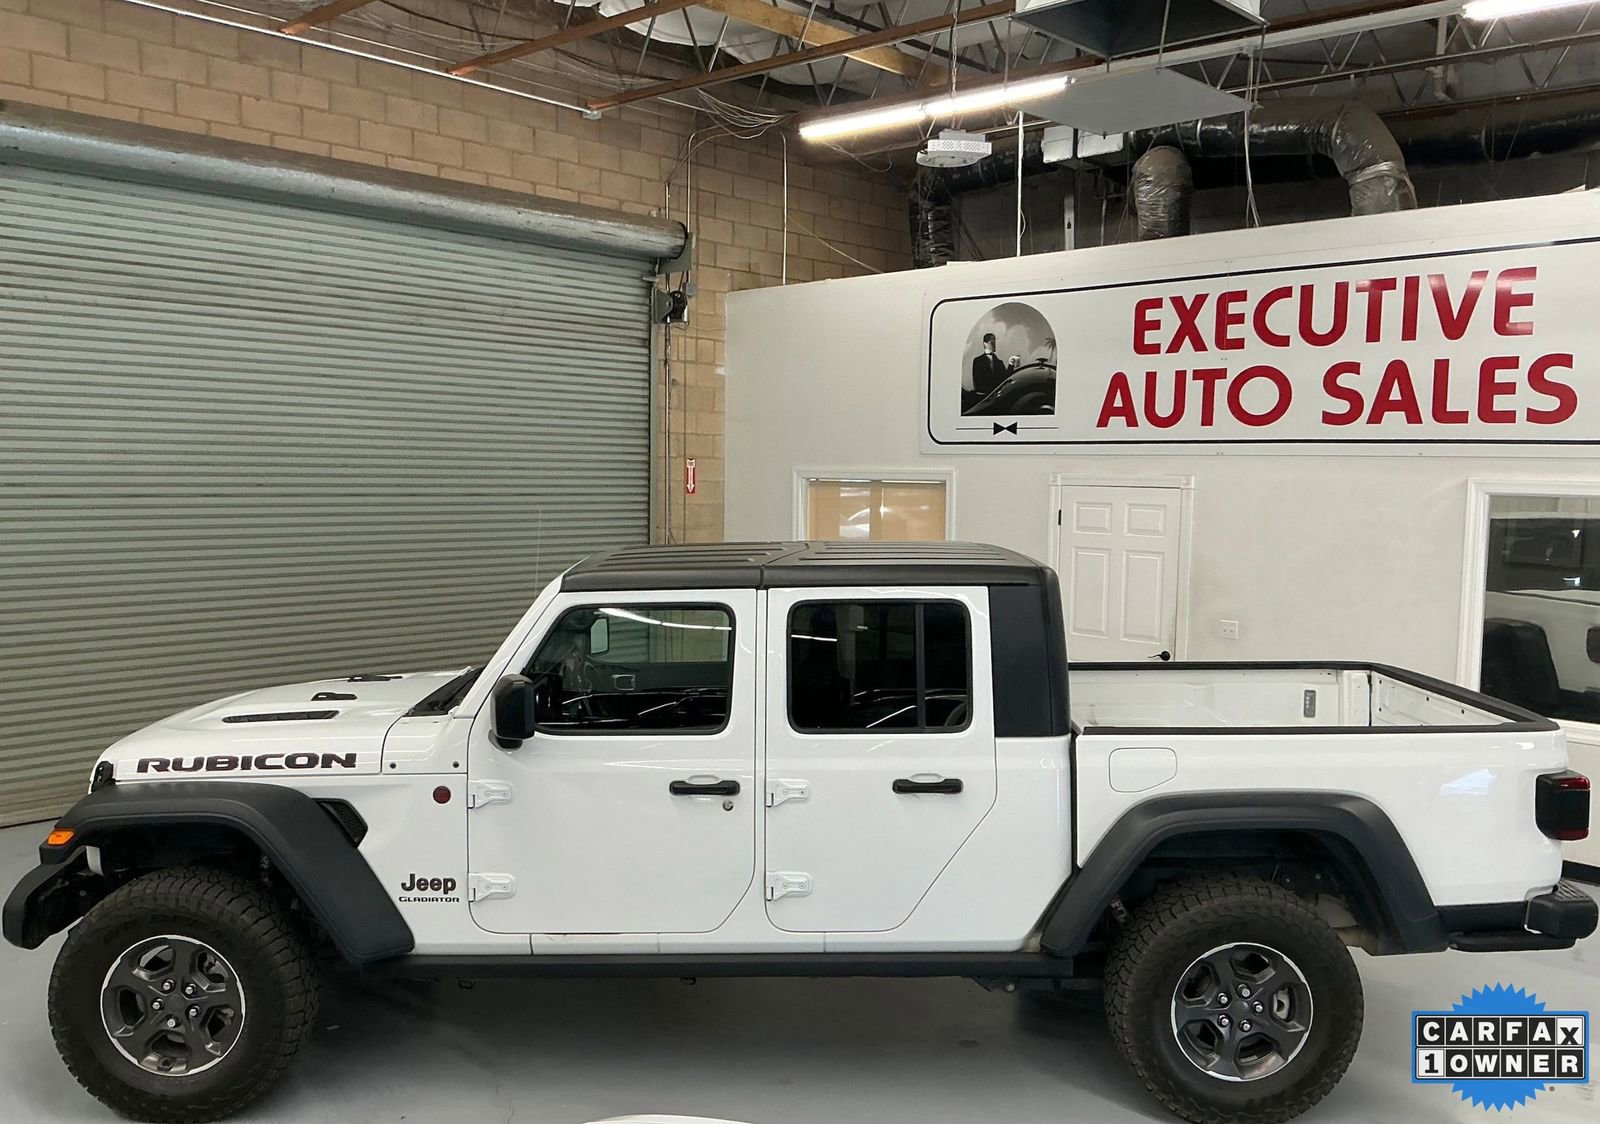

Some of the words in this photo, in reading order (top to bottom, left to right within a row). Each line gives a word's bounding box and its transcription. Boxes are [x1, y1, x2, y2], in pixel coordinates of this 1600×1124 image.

[1132, 266, 1538, 356] EXECUTIVE
[1096, 363, 1293, 429] AUTO
[1321, 353, 1579, 426] SALES
[136, 752, 357, 773] RUBICON
[400, 873, 457, 895] Jeep
